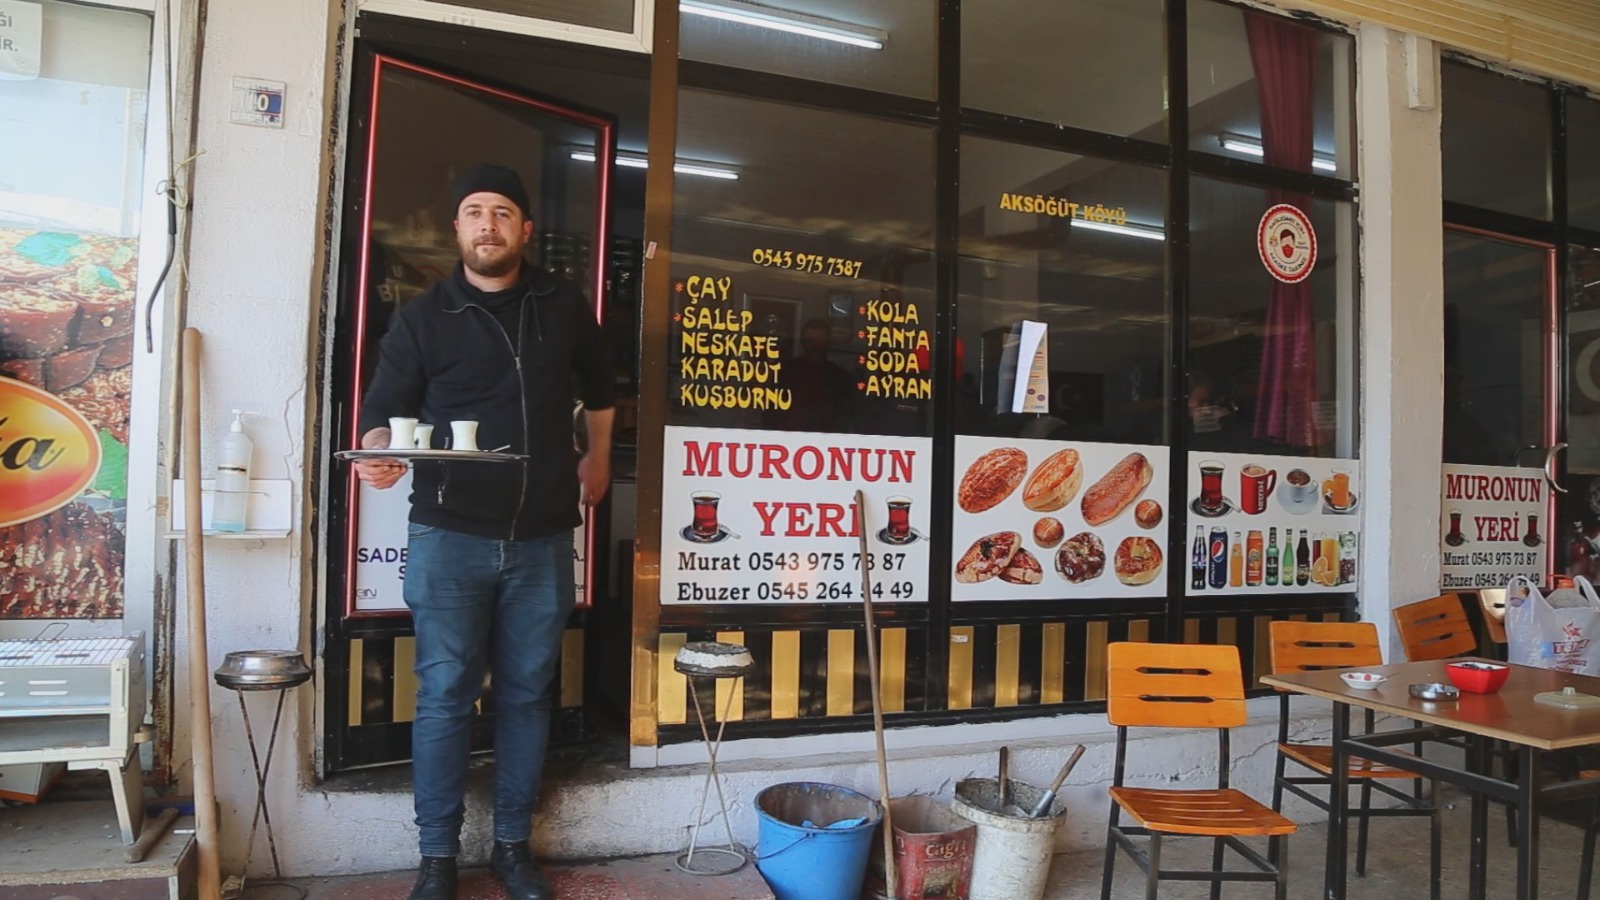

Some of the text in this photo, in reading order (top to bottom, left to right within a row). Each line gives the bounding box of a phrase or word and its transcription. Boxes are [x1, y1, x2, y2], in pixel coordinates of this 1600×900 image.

[1000, 193, 1127, 225] AKSÖĞÜT KÖYÜ
[752, 248, 863, 279] 0543 975 7387
[686, 275, 731, 305] ÇAY
[682, 306, 753, 333] SALEP
[866, 299, 919, 325] KOLA
[681, 331, 780, 359] NESKAFE
[866, 325, 930, 351] FANTA
[680, 356, 781, 384] KARADUT
[866, 349, 920, 374] SODA
[865, 374, 932, 400] AYRAN
[682, 441, 916, 483] MURONUN
[1446, 474, 1542, 502] MURONUN
[1474, 511, 1520, 542] YERİ
[677, 552, 741, 571] Murat
[748, 552, 800, 571] 0543
[807, 552, 845, 571] 975
[883, 553, 906, 571] 87
[1443, 552, 1537, 566] Murat 0543 975 73 87
[677, 582, 750, 601] Ebuzer
[757, 582, 808, 600] 0545
[816, 582, 853, 600] 264
[890, 581, 913, 599] 49
[1443, 573, 1473, 587] Ebuzer
[1475, 573, 1497, 587] 0545
